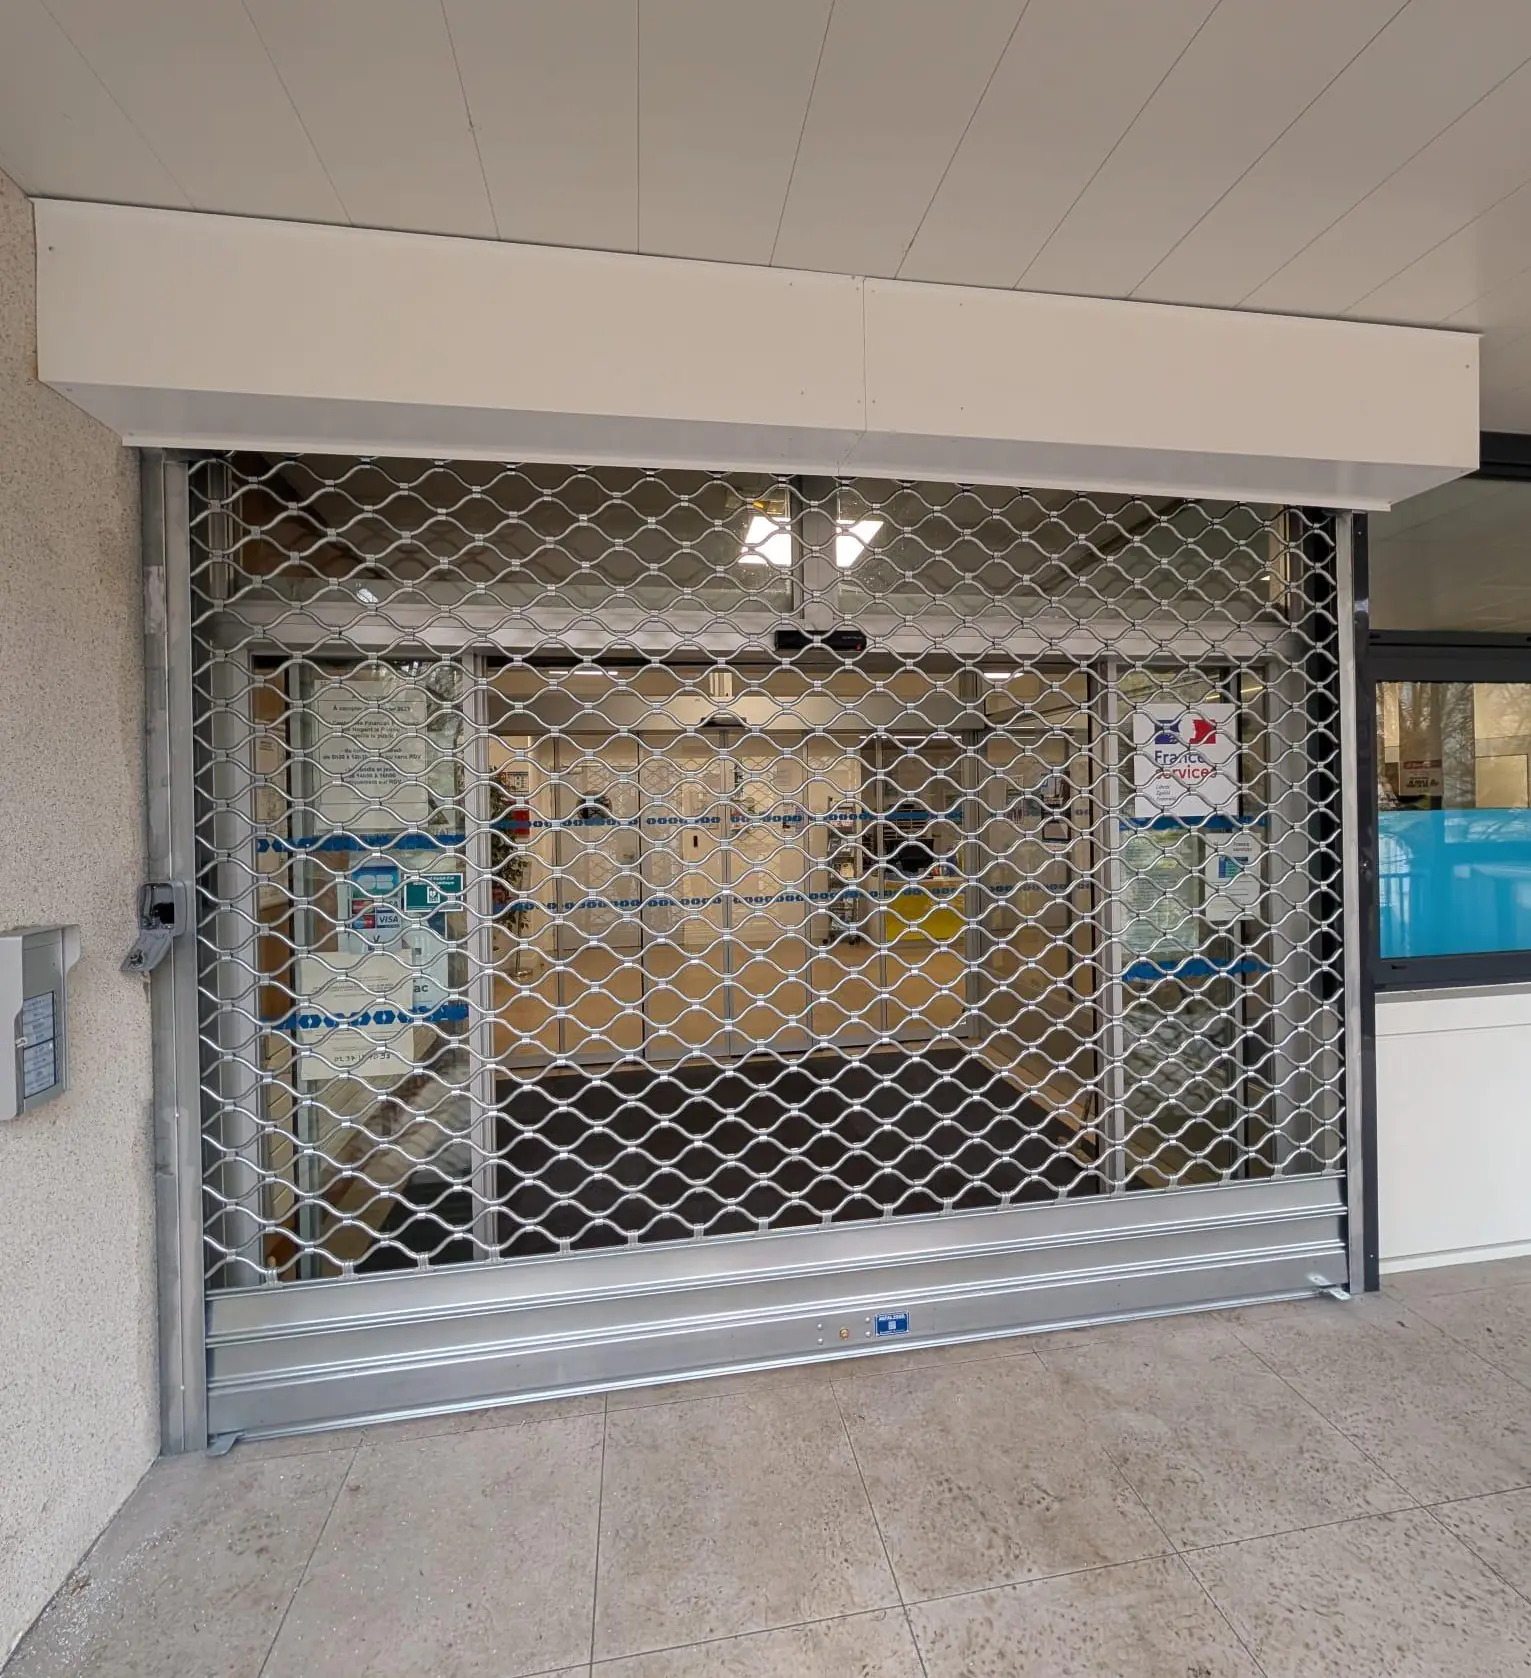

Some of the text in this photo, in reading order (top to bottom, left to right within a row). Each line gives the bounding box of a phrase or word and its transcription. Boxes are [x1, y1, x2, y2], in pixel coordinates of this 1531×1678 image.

[1154, 750, 1207, 765] France
[1155, 764, 1217, 780] services
[379, 915, 399, 924] VISA
